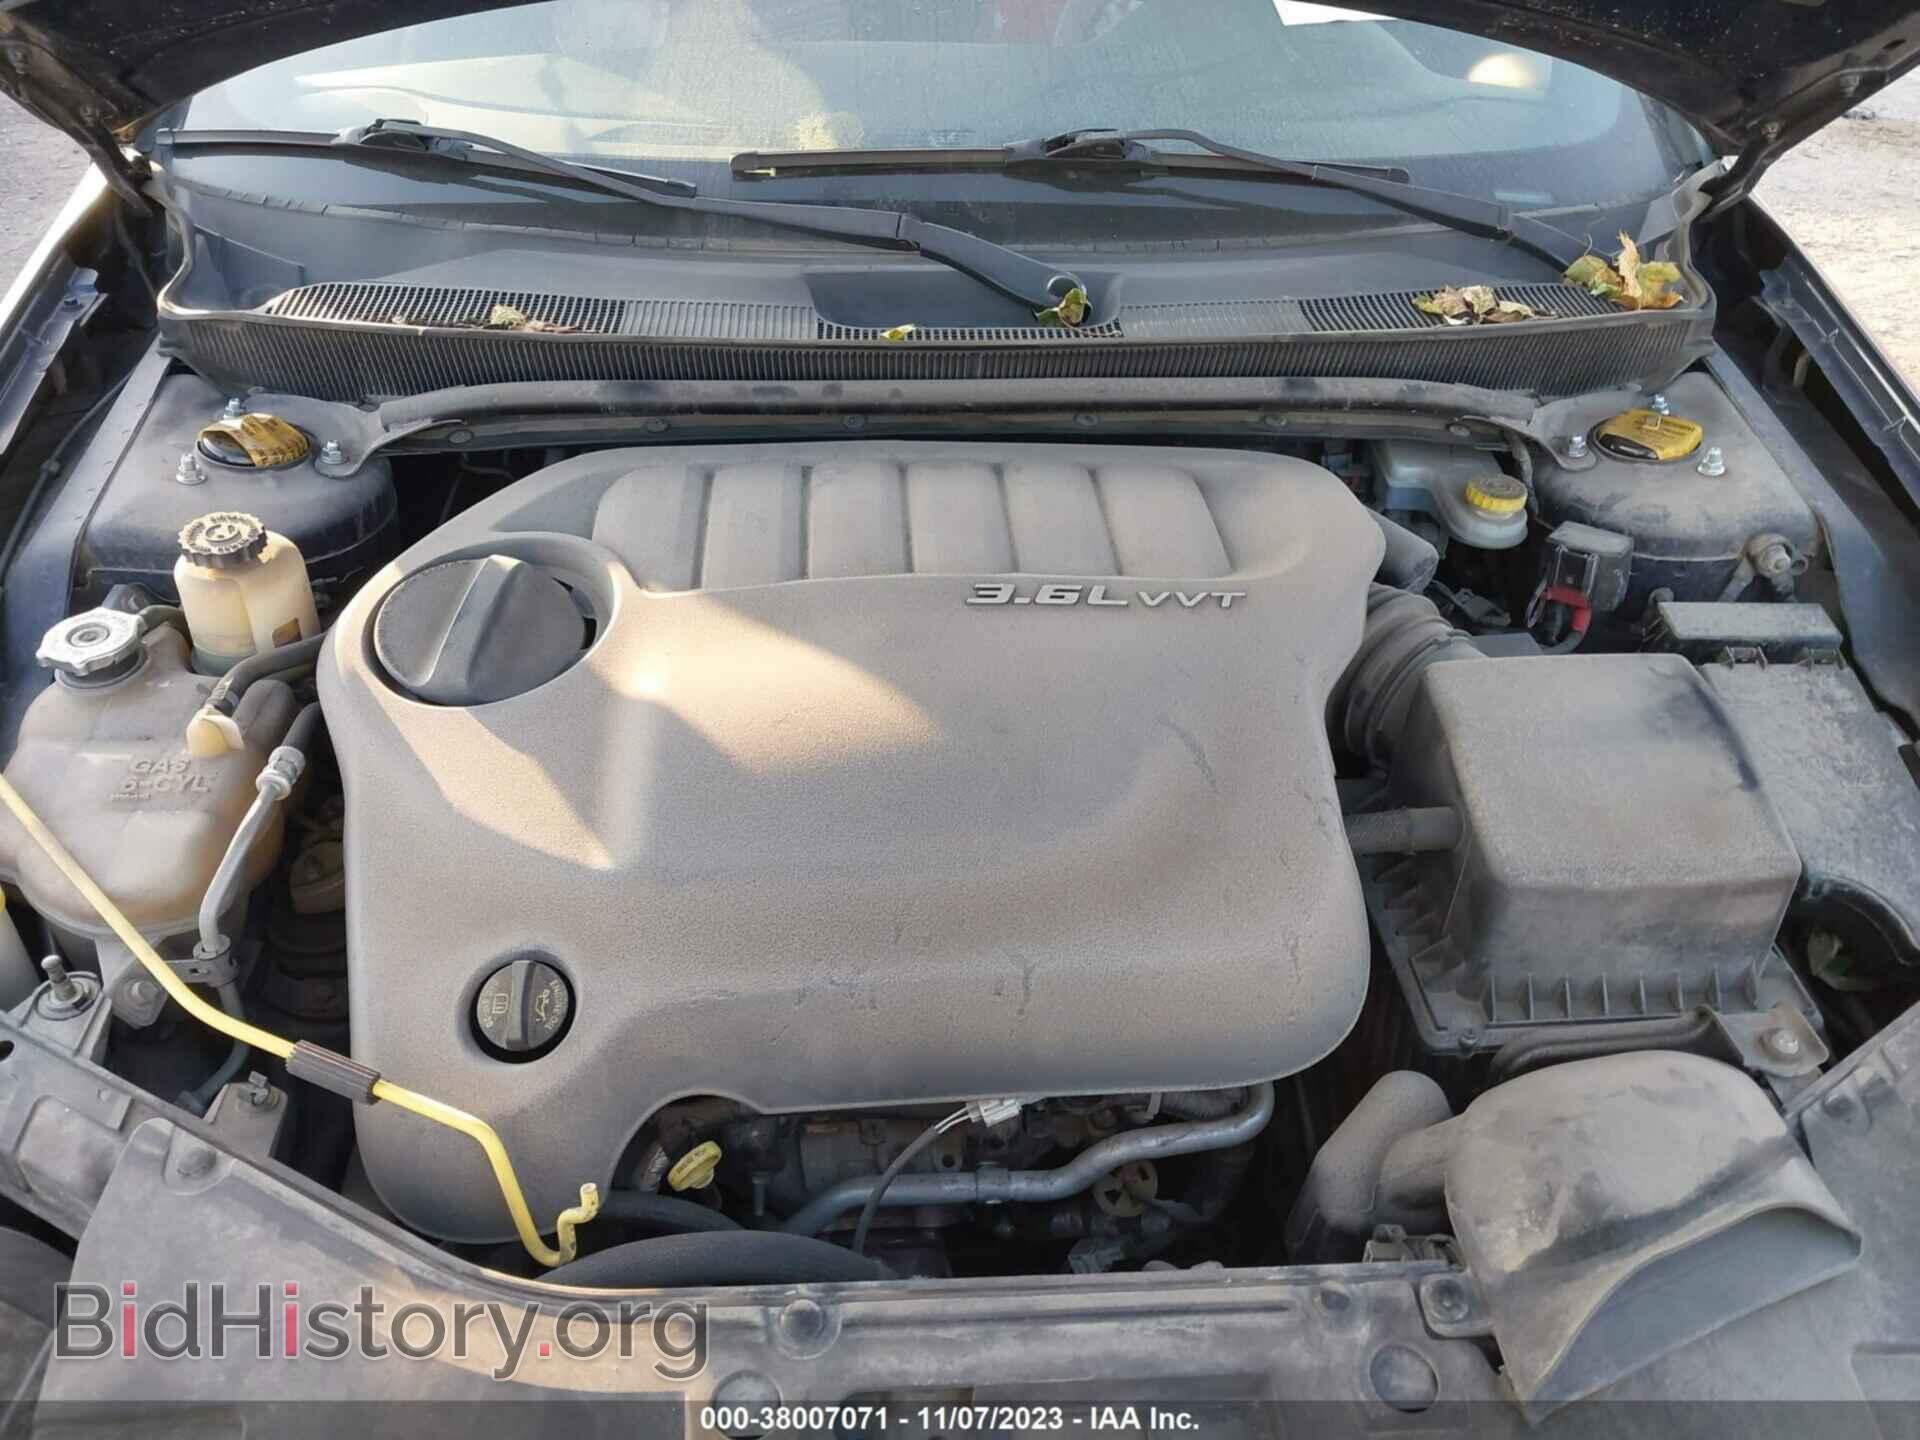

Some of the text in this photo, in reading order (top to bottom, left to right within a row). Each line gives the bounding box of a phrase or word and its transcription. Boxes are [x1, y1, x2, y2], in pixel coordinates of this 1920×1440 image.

[966, 583, 1247, 608] 3.6L VVT
[135, 759, 192, 774] GAS
